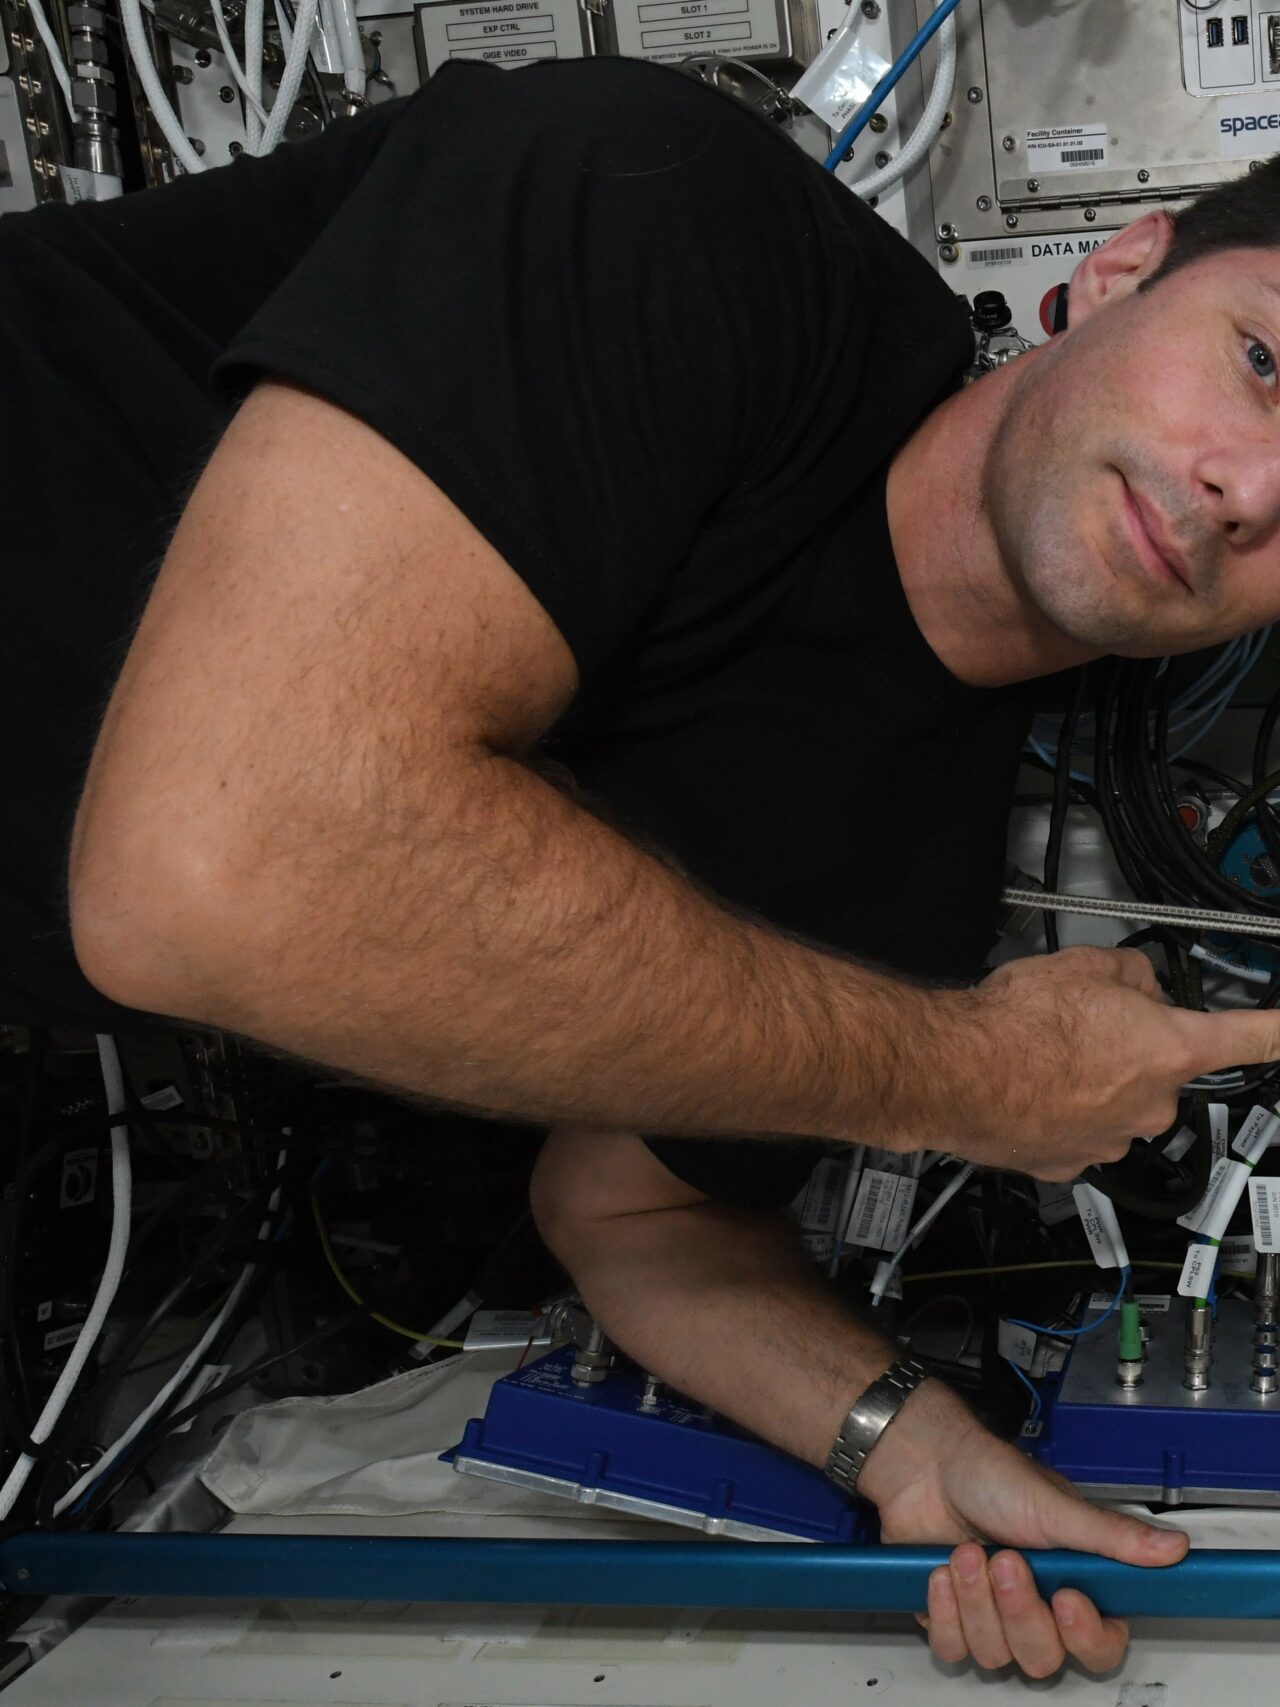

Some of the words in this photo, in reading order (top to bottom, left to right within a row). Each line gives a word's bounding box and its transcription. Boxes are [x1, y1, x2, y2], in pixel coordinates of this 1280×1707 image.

[459, 5, 491, 16] SYSTEM
[492, 3, 515, 14] HARD
[516, 1, 540, 11] DRIVE
[680, 6, 702, 14] SLOT
[483, 25, 498, 33] EXP
[500, 23, 521, 32] CTRL
[683, 31, 705, 40] SLOT
[705, 31, 712, 39] 2
[482, 50, 502, 59] GIGE
[503, 48, 528, 57] VIDEO
[1026, 130, 1050, 138] Facility
[1051, 128, 1083, 136] Container
[1031, 242, 1074, 258] DATA
[1256, 1112, 1265, 1122] To
[1240, 1121, 1259, 1148] Payload
[1083, 1218, 1094, 1236] PWR
[1086, 1208, 1092, 1218] To
[1089, 1218, 1103, 1244] CPLSW
[1193, 1249, 1200, 1259] To
[1186, 1260, 1198, 1288] CPLSW
